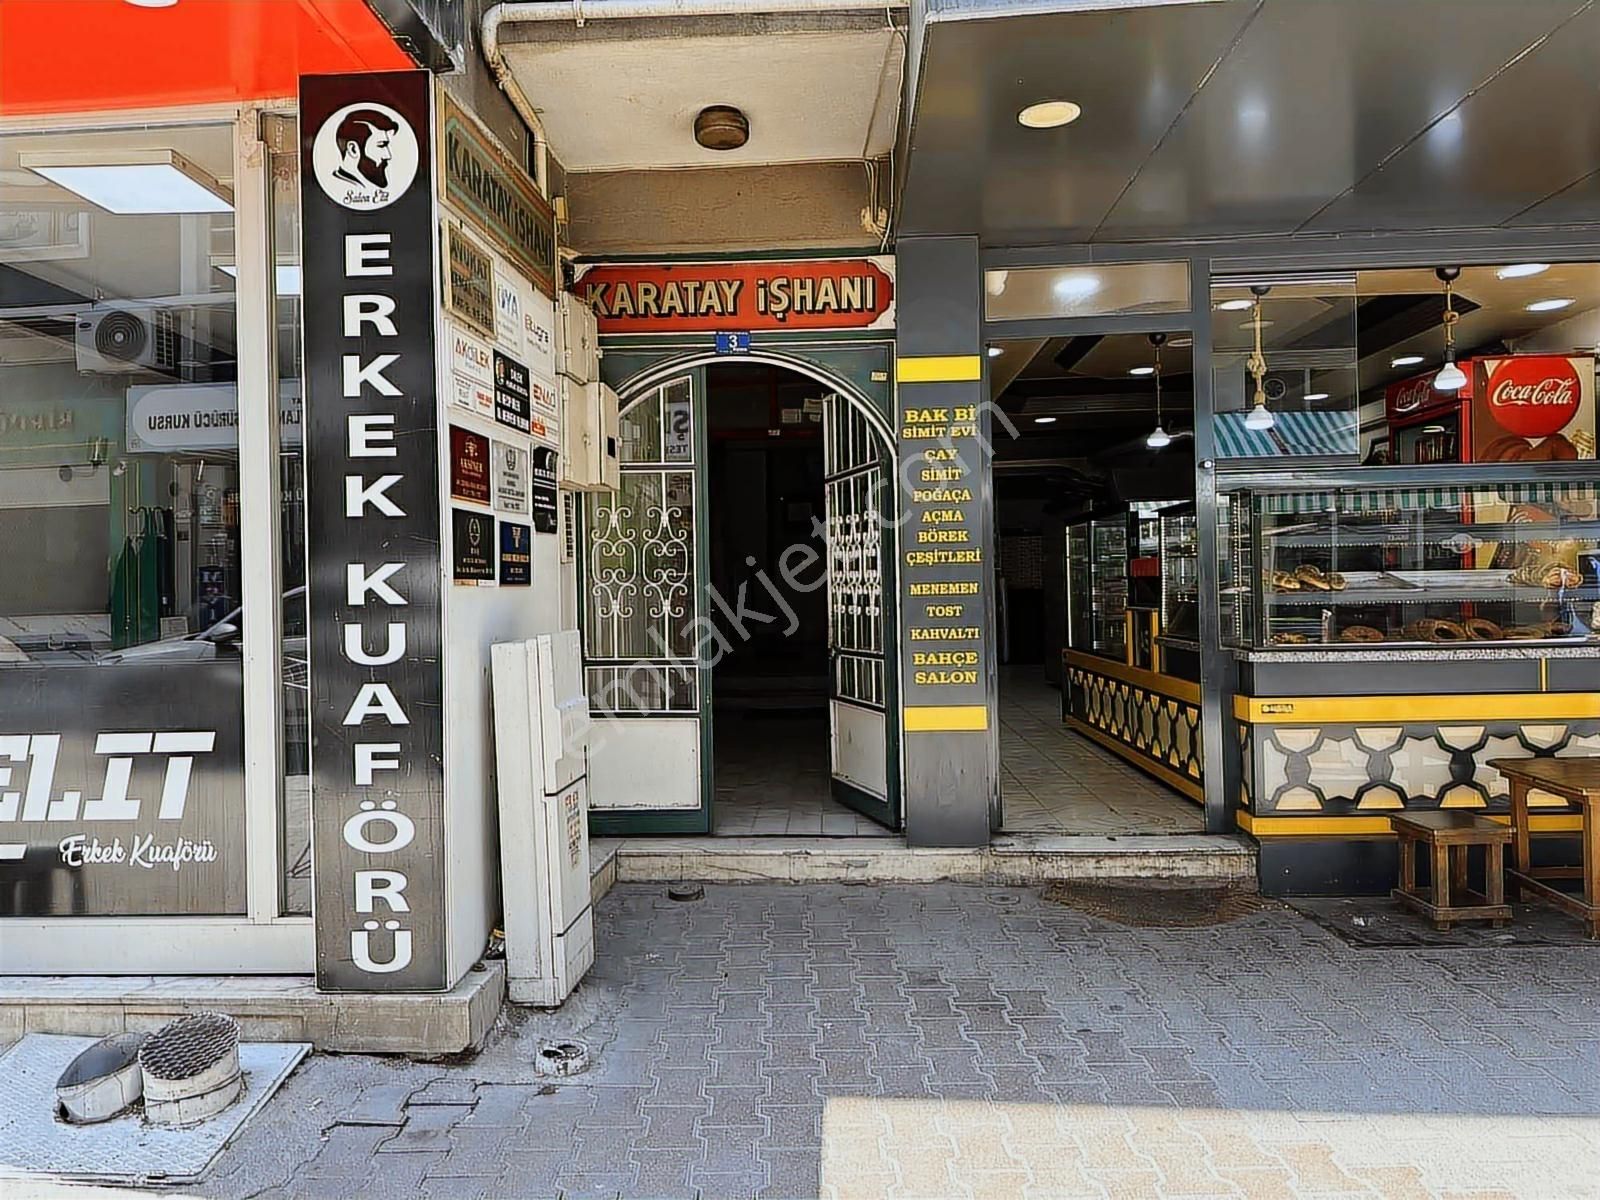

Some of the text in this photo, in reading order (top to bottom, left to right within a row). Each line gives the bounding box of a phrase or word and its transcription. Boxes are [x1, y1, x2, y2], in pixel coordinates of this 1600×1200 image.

[586, 279, 743, 317] KARATAY
[728, 334, 738, 348] 3
[1493, 377, 1577, 406] Coca-Cola
[905, 405, 976, 423] BAK Bİ
[903, 424, 977, 438] SİMİT EVİ
[925, 449, 958, 464] ÇAY
[921, 467, 962, 482] SİMİT
[913, 487, 971, 503] POĞAÇA
[921, 510, 964, 525] AÇMA
[918, 527, 968, 542] BÖREK
[906, 548, 981, 564] ÇEŞİTLERİ
[910, 582, 979, 595] MENEMEN
[342, 233, 415, 973] ERKEK KUAFÖRÜ
[927, 605, 963, 618] TOST
[911, 627, 980, 640] KAHVALTI
[913, 652, 978, 668] BAHÇE
[914, 670, 978, 685] SALON
[59, 834, 218, 871] Erkek Kuaförü
